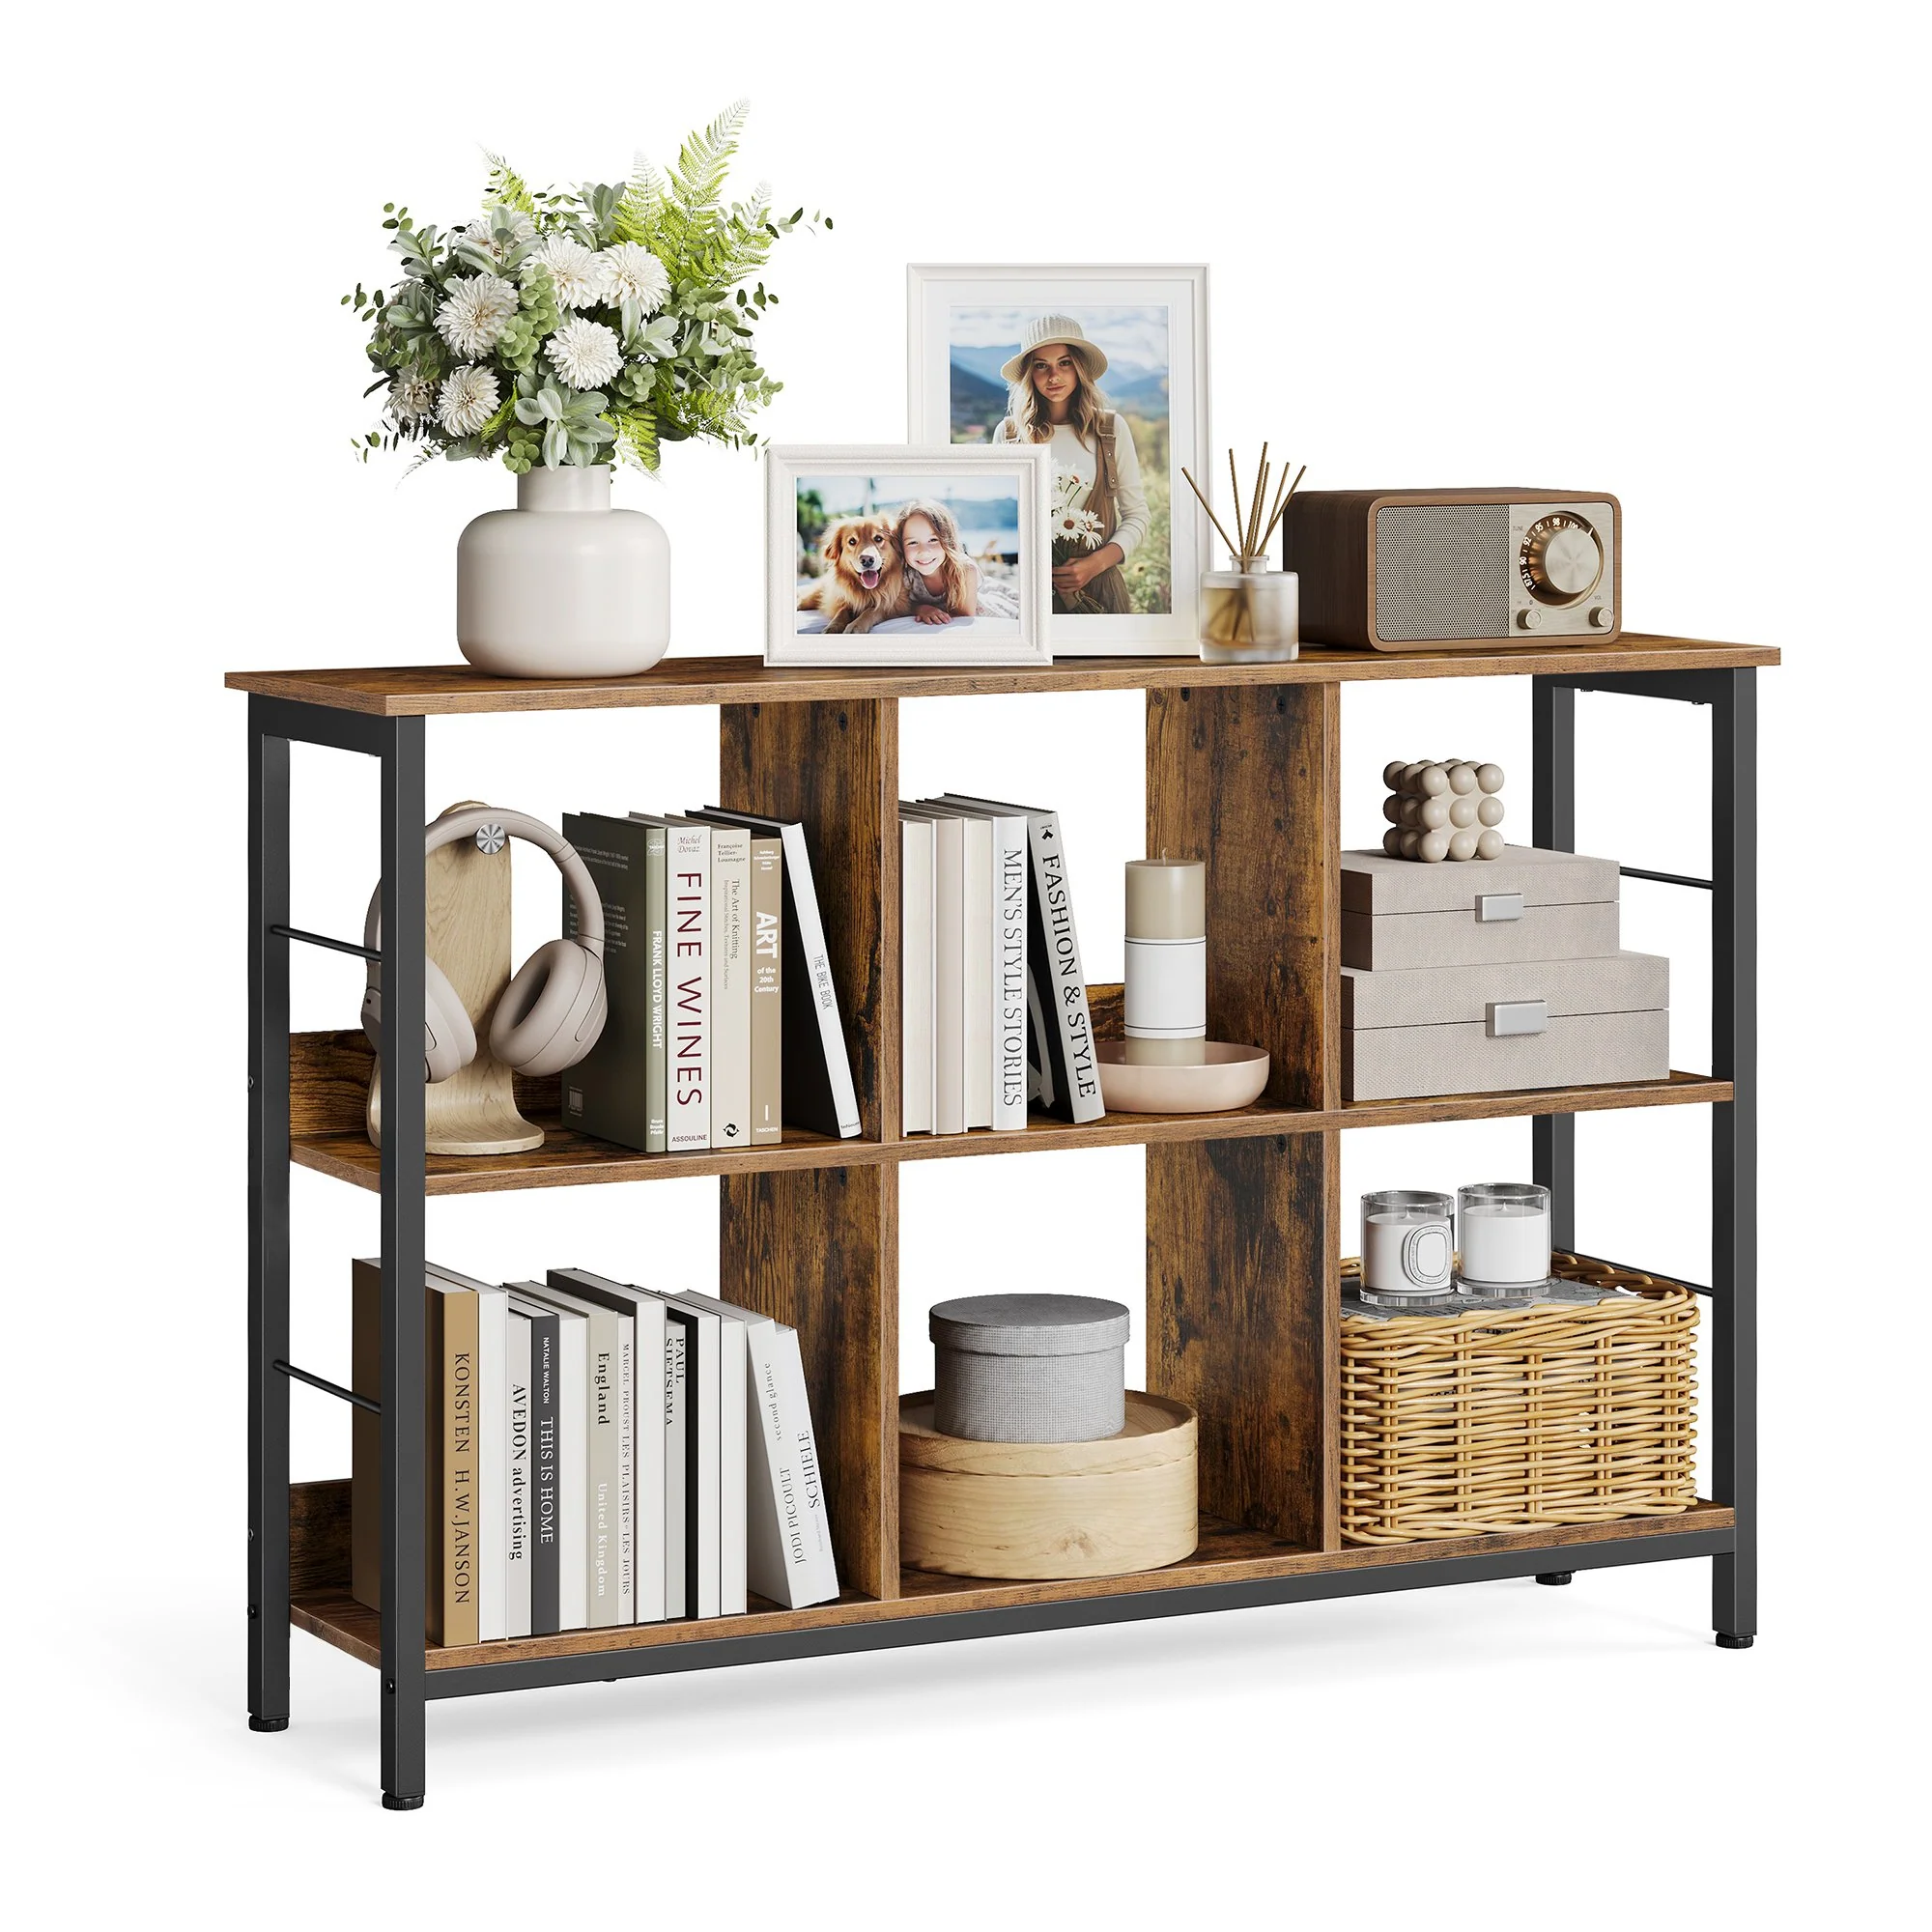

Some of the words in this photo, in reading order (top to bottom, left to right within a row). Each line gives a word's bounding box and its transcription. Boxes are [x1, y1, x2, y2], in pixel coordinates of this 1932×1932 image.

[1522, 536, 1532, 546] 92
[1534, 522, 1544, 532] 95
[1551, 517, 1561, 526] 98
[1519, 556, 1527, 566] 90
[677, 834, 702, 845] Michel
[1003, 849, 1023, 921] MEN'S
[676, 872, 702, 957] FINE
[732, 913, 740, 923] of
[755, 911, 778, 958] ART
[1042, 854, 1078, 977] FASHION
[652, 930, 663, 966] FRANK
[729, 924, 740, 959] Knitting
[813, 954, 826, 970] THE
[652, 968, 663, 1003] LLOYD
[816, 971, 830, 988] BIKE
[1003, 927, 1023, 1001] STYLE
[753, 985, 780, 994] Century
[820, 989, 834, 1010] BOOK
[1063, 985, 1081, 1007] &
[652, 1004, 663, 1048] WRIGHT
[676, 976, 702, 1106] WINES
[1003, 1008, 1023, 1106] STORIES
[1067, 1012, 1096, 1097] STYLE
[671, 1133, 708, 1144] ASSOULINE
[675, 1338, 685, 1383] PAUL
[764, 1363, 779, 1398] glance
[454, 1352, 470, 1453] KONSTEN
[594, 1352, 611, 1425] England
[512, 1384, 527, 1461] AVEDON
[540, 1417, 554, 1460] THIS
[770, 1404, 781, 1441] second
[540, 1464, 554, 1481] IS
[798, 1430, 821, 1509] SCHIELE
[508, 1467, 526, 1560] advertising
[540, 1487, 554, 1544] HOME
[597, 1483, 608, 1529] United
[780, 1467, 798, 1527] PICOULT
[451, 1469, 470, 1604] H.W.JANSON
[790, 1532, 808, 1564] JODI
[595, 1535, 608, 1597] Kingdom
